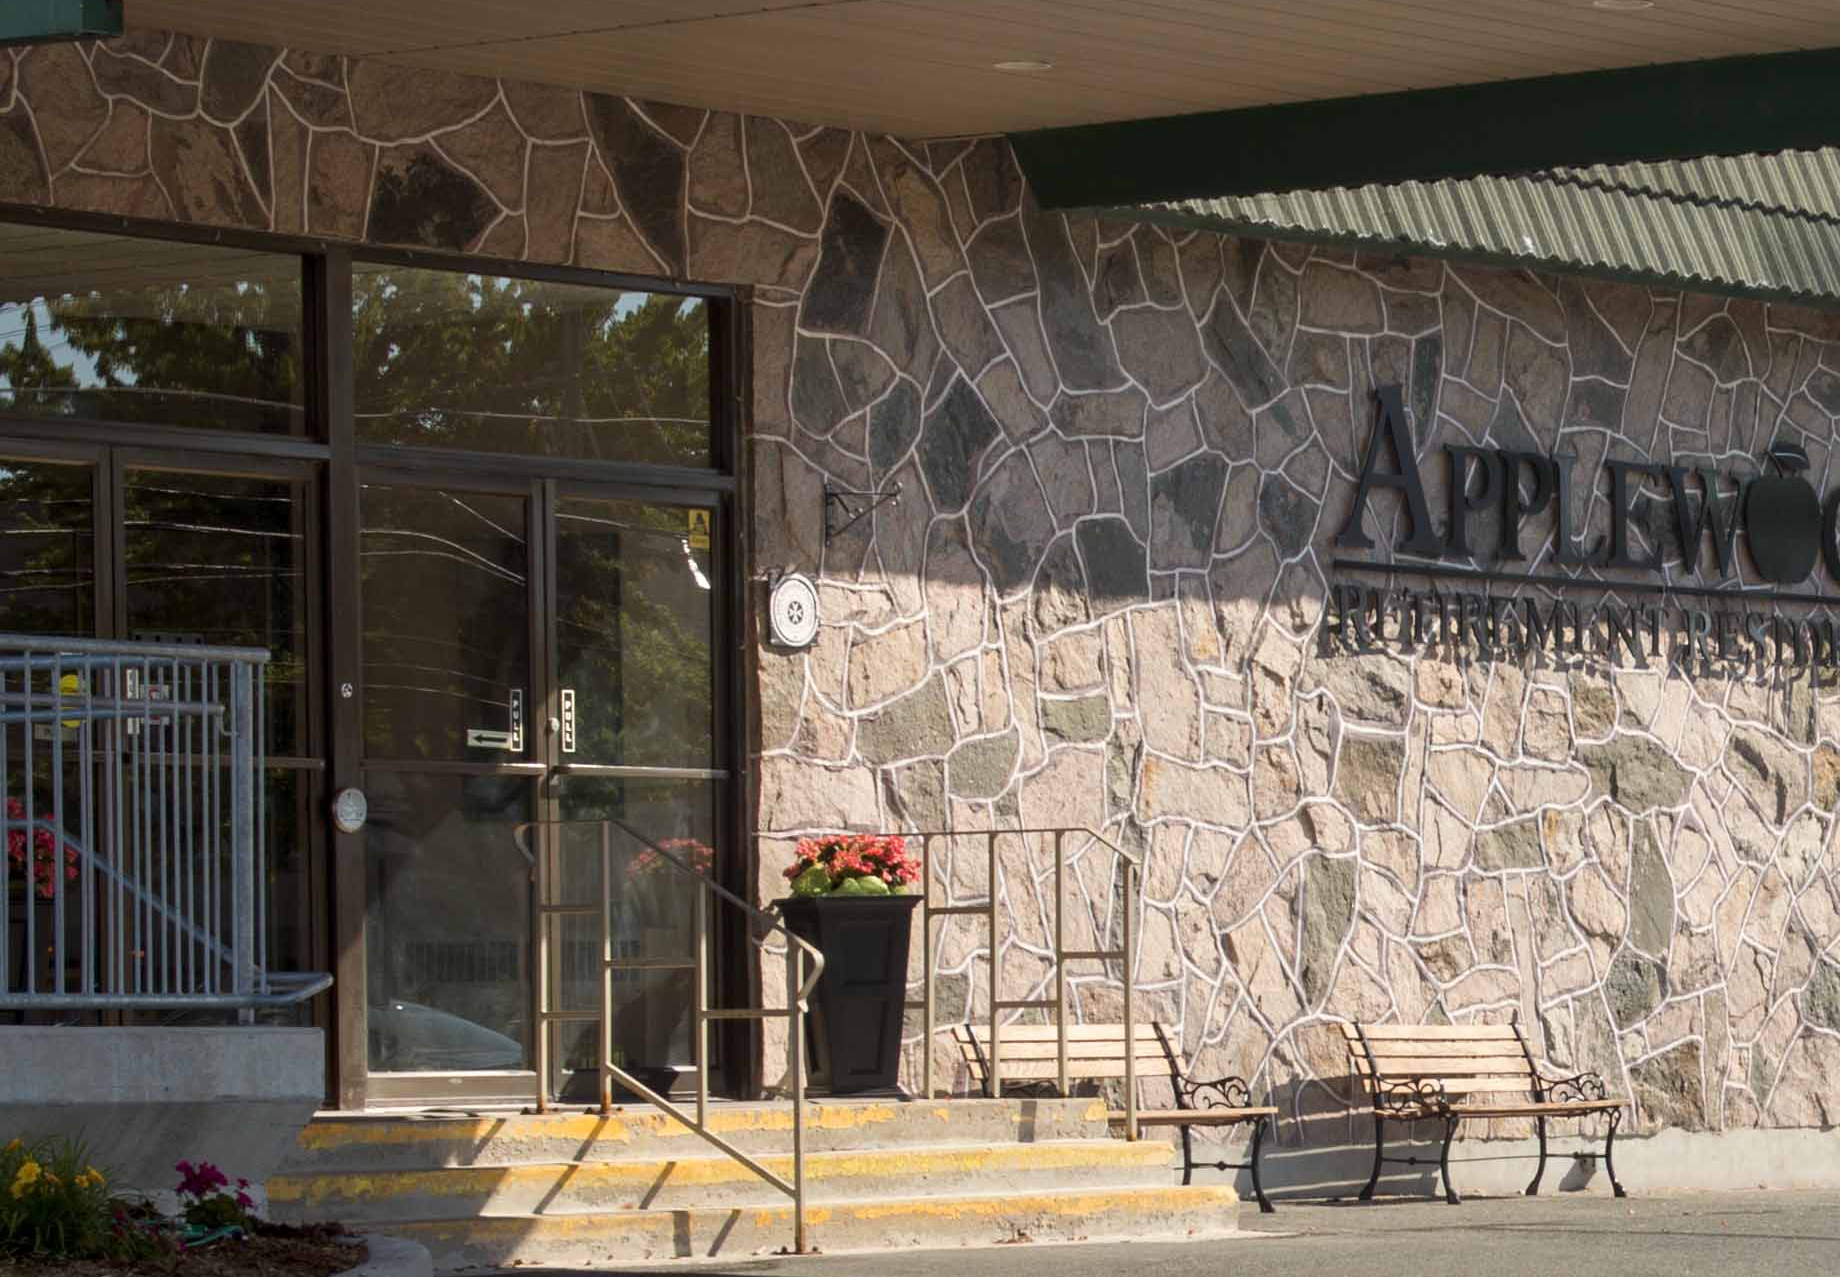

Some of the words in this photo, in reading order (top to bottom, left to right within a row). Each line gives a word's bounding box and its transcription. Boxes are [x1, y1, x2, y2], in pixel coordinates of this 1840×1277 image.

[1332, 584, 1666, 657] RETIREMENT
[512, 699, 520, 742] PULL
[564, 700, 573, 743] PULL
